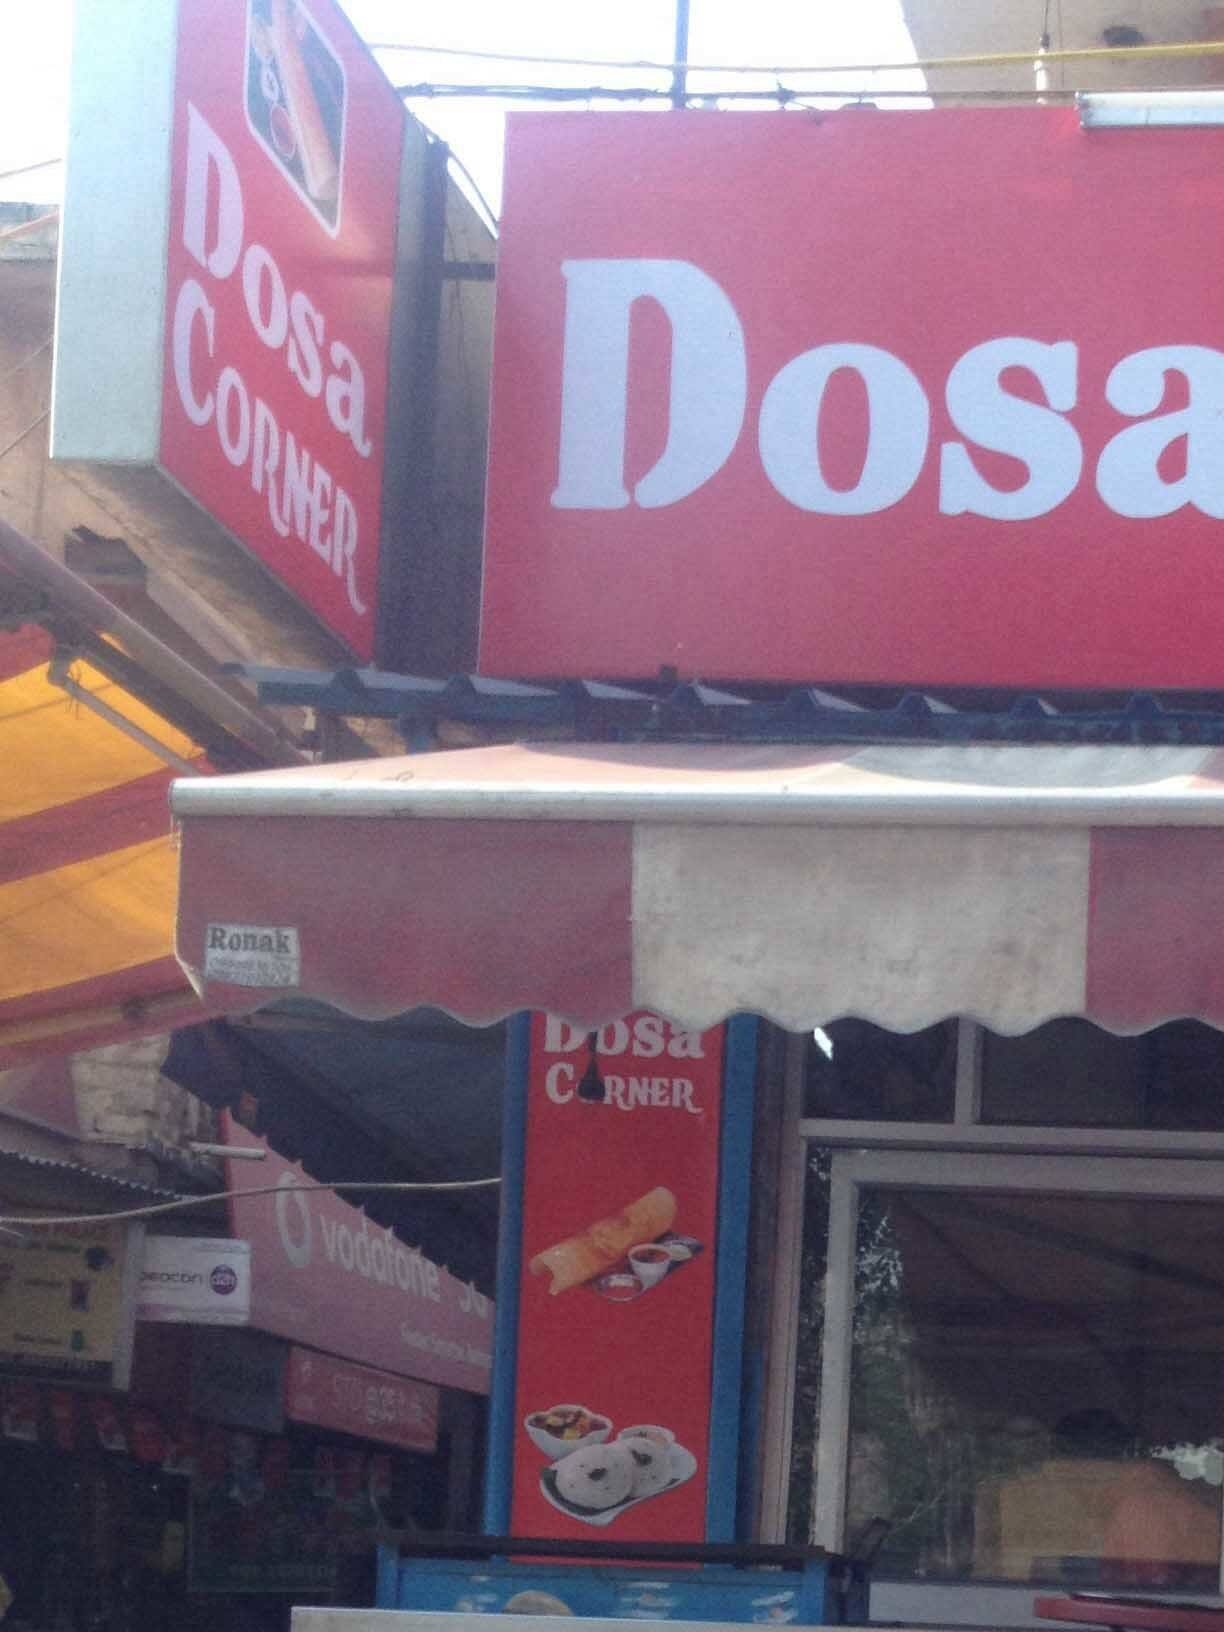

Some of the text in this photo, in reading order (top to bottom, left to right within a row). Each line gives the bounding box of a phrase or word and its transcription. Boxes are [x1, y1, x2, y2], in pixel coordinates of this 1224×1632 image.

[173, 280, 366, 616] CORNER
[208, 927, 291, 953] Ronak
[545, 1061, 704, 1115] CRNER
